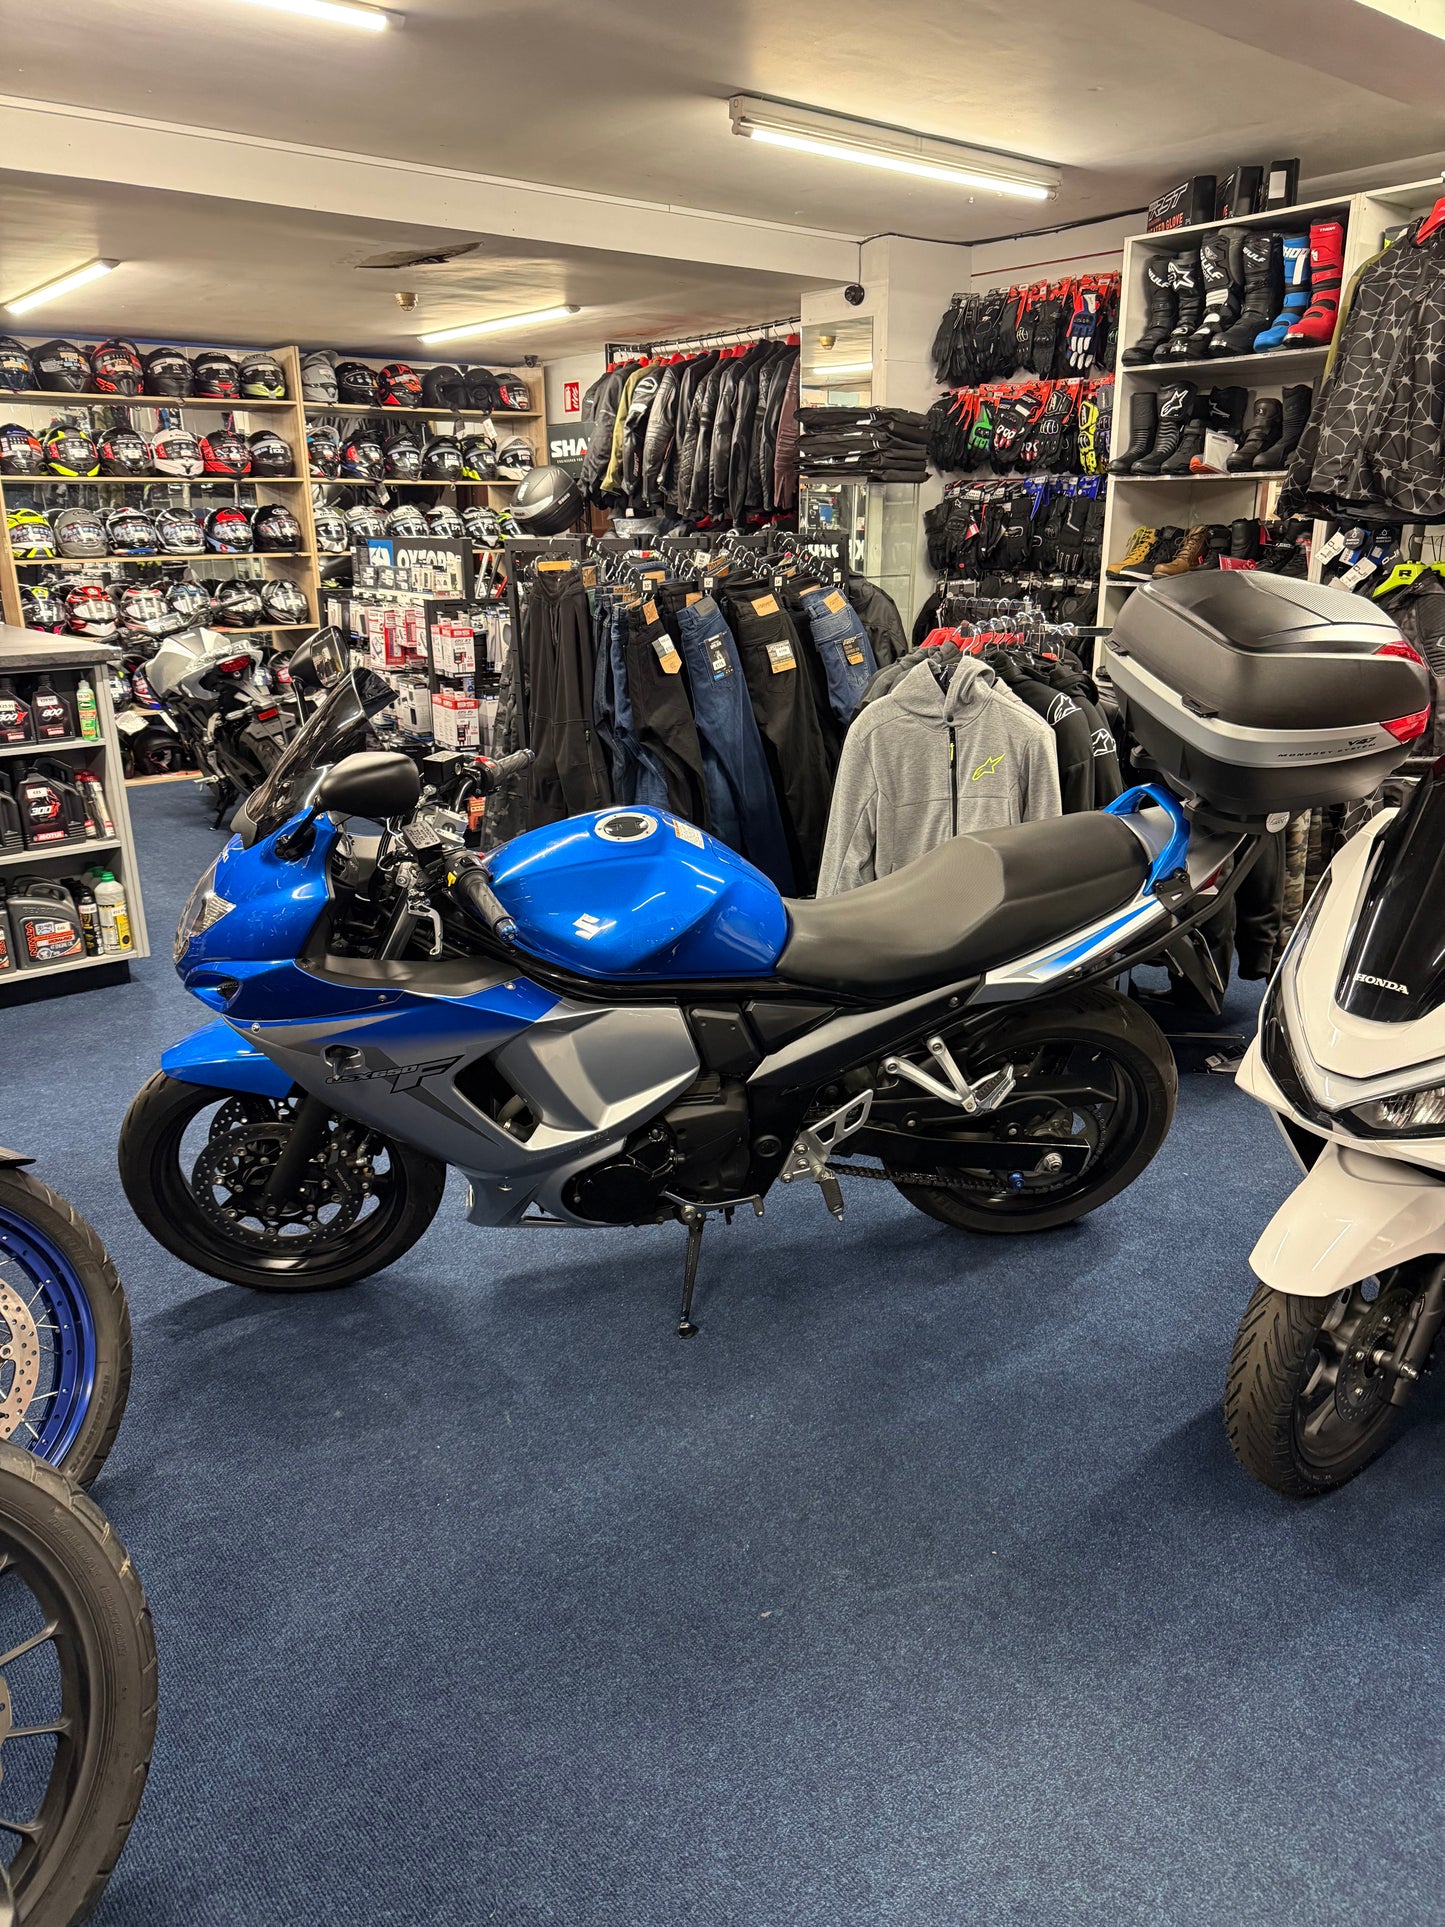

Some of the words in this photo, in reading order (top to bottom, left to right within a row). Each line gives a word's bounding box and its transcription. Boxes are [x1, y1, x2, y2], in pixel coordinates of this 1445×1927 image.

[1166, 213, 1184, 230] GLOVE
[551, 437, 590, 458] SHA
[1337, 743, 1376, 753] SYSTEM
[38, 831, 64, 841] MOTUL
[1352, 973, 1409, 995] HONDA
